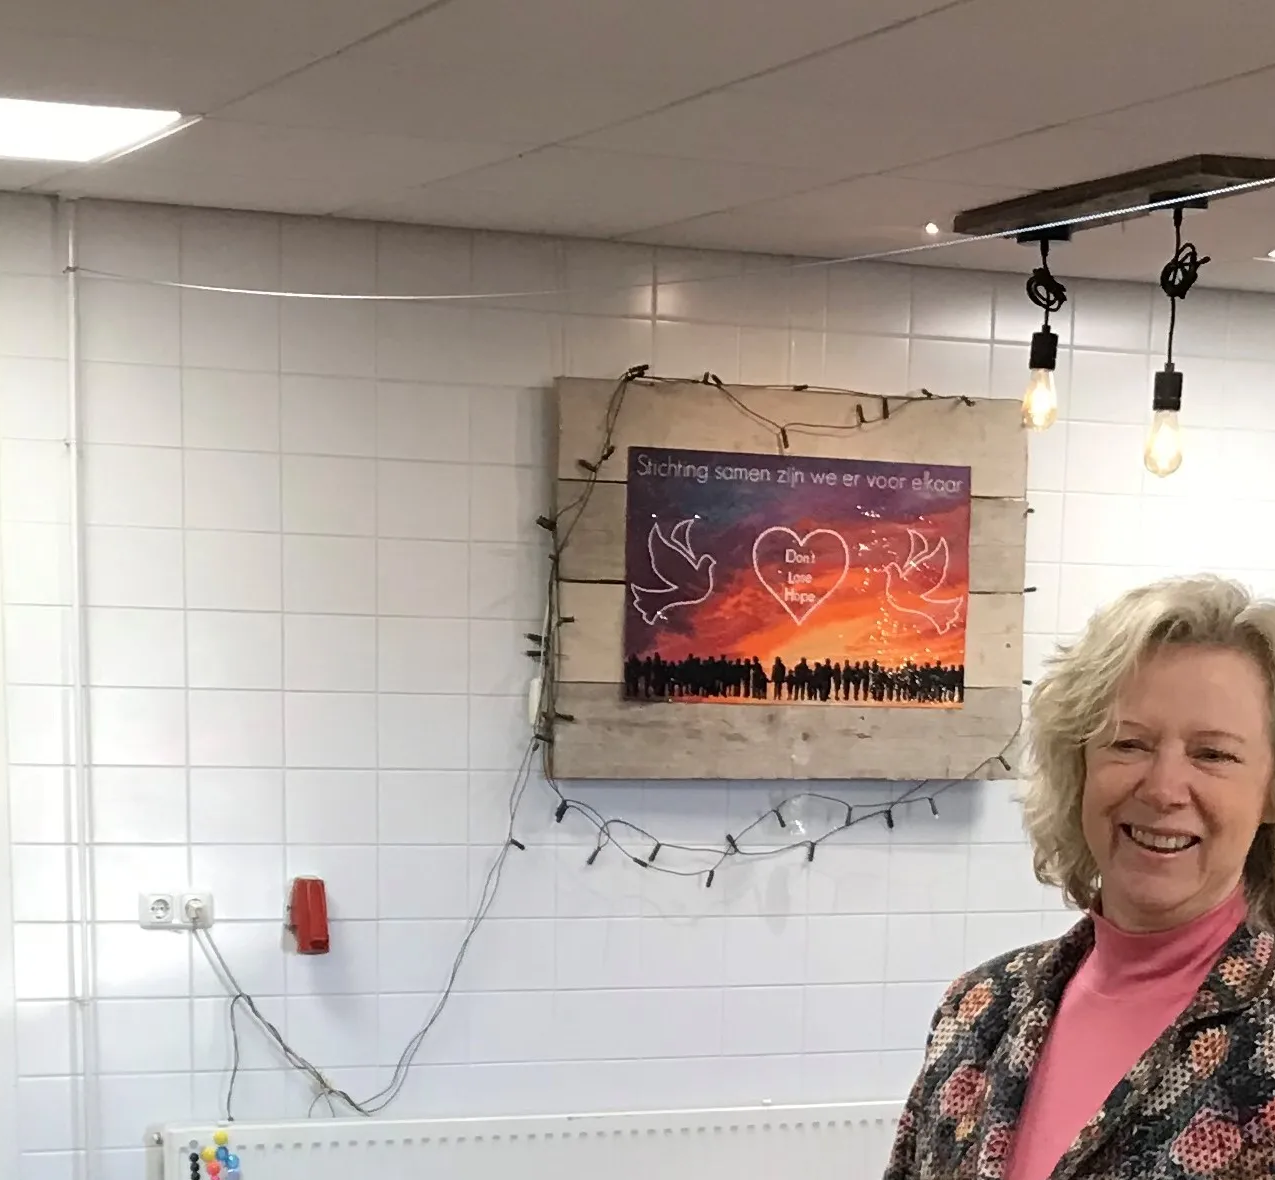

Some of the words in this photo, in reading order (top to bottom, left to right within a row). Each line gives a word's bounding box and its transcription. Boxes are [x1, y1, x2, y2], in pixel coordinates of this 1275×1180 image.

[637, 453, 709, 484] Stichting
[714, 465, 771, 483] samen
[776, 466, 805, 488] zijn
[810, 471, 838, 486] we
[842, 473, 861, 487] er
[866, 475, 908, 490] voor
[784, 587, 816, 604] Hope
